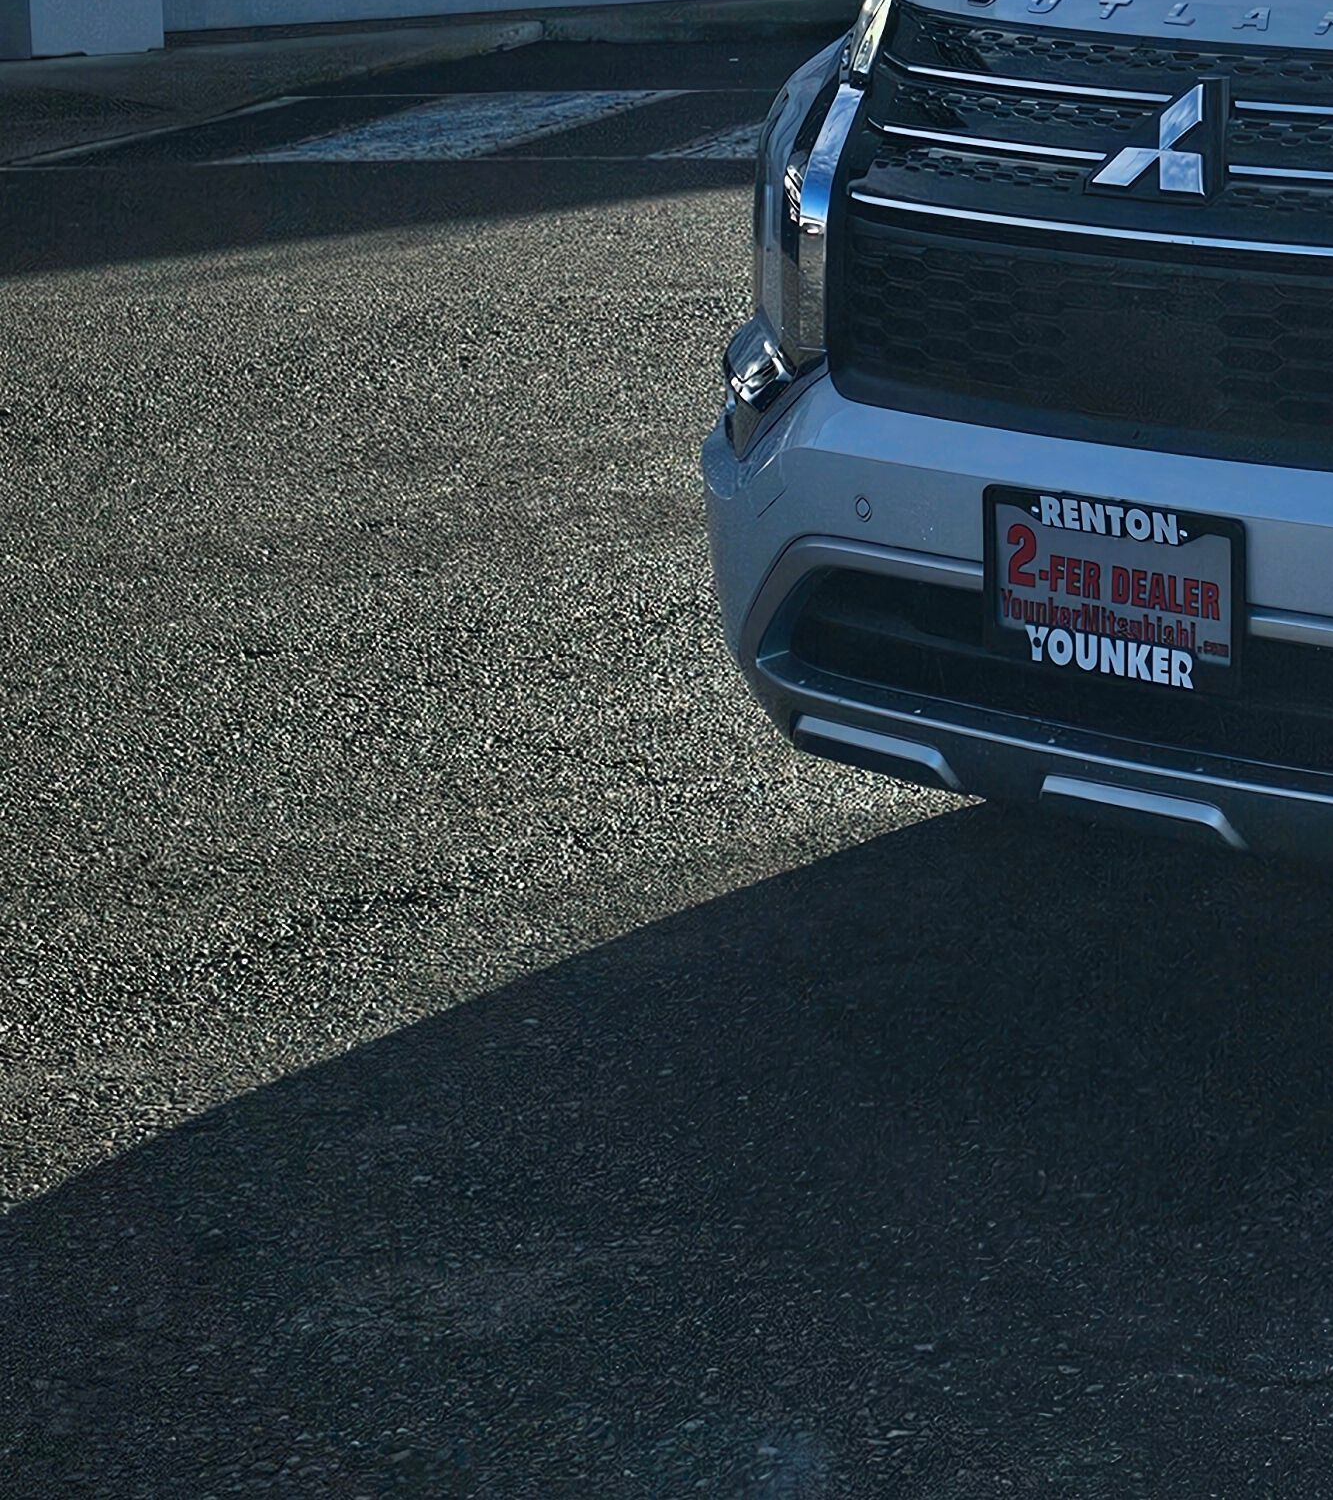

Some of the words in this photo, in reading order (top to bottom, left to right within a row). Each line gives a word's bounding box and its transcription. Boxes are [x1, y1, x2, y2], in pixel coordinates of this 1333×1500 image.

[1039, 495, 1179, 546] RENTON
[1007, 523, 1101, 601] 2-FER
[1111, 565, 1221, 622] DEALER
[1025, 624, 1195, 690] YOUNKER
